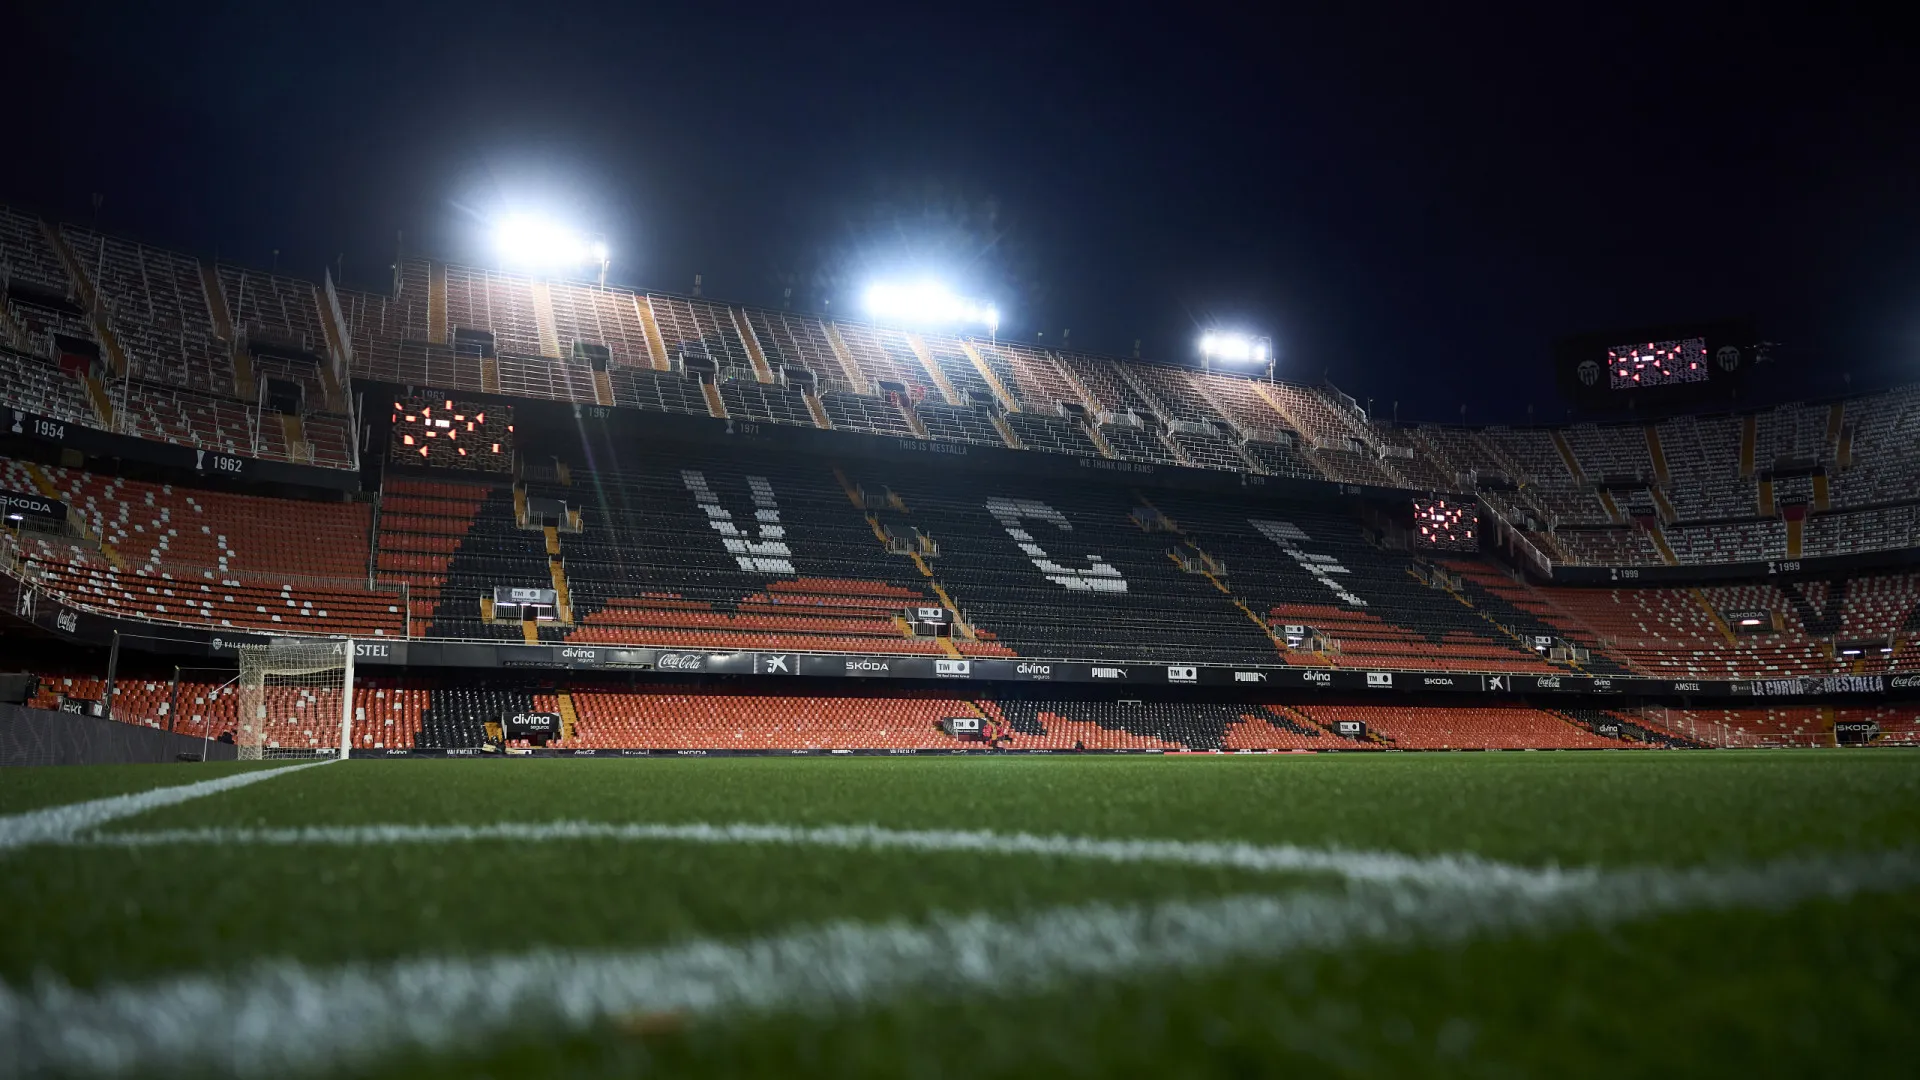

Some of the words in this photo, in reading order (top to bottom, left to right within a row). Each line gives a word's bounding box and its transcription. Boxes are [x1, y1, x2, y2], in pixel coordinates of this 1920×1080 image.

[34, 419, 64, 440] 1954
[899, 440, 917, 450] THIS
[919, 442, 927, 451] IS
[929, 443, 967, 455] MESTALLA
[213, 455, 243, 473] 1962
[1080, 458, 1091, 468] WE
[1093, 460, 1116, 470] THANK
[1117, 462, 1132, 472] OUR
[680, 469, 796, 574] V
[985, 496, 1129, 594] C
[1246, 518, 1369, 607] F
[1779, 561, 1800, 572] 1999
[1620, 569, 1639, 578] 1999
[332, 643, 386, 657] ASTEL
[562, 648, 594, 659] divina
[938, 663, 950, 671] TM
[1016, 662, 1050, 674] divina
[1091, 667, 1119, 678] PUMA
[1235, 672, 1259, 682] PUMA
[1303, 670, 1331, 682] divina
[1674, 682, 1700, 691] AMSTEL
[1750, 680, 1765, 696] LA
[1765, 679, 1804, 696] CURVA
[1824, 676, 1884, 693] MESTALLA
[513, 714, 550, 724] divina
[1600, 724, 1618, 732] divina
